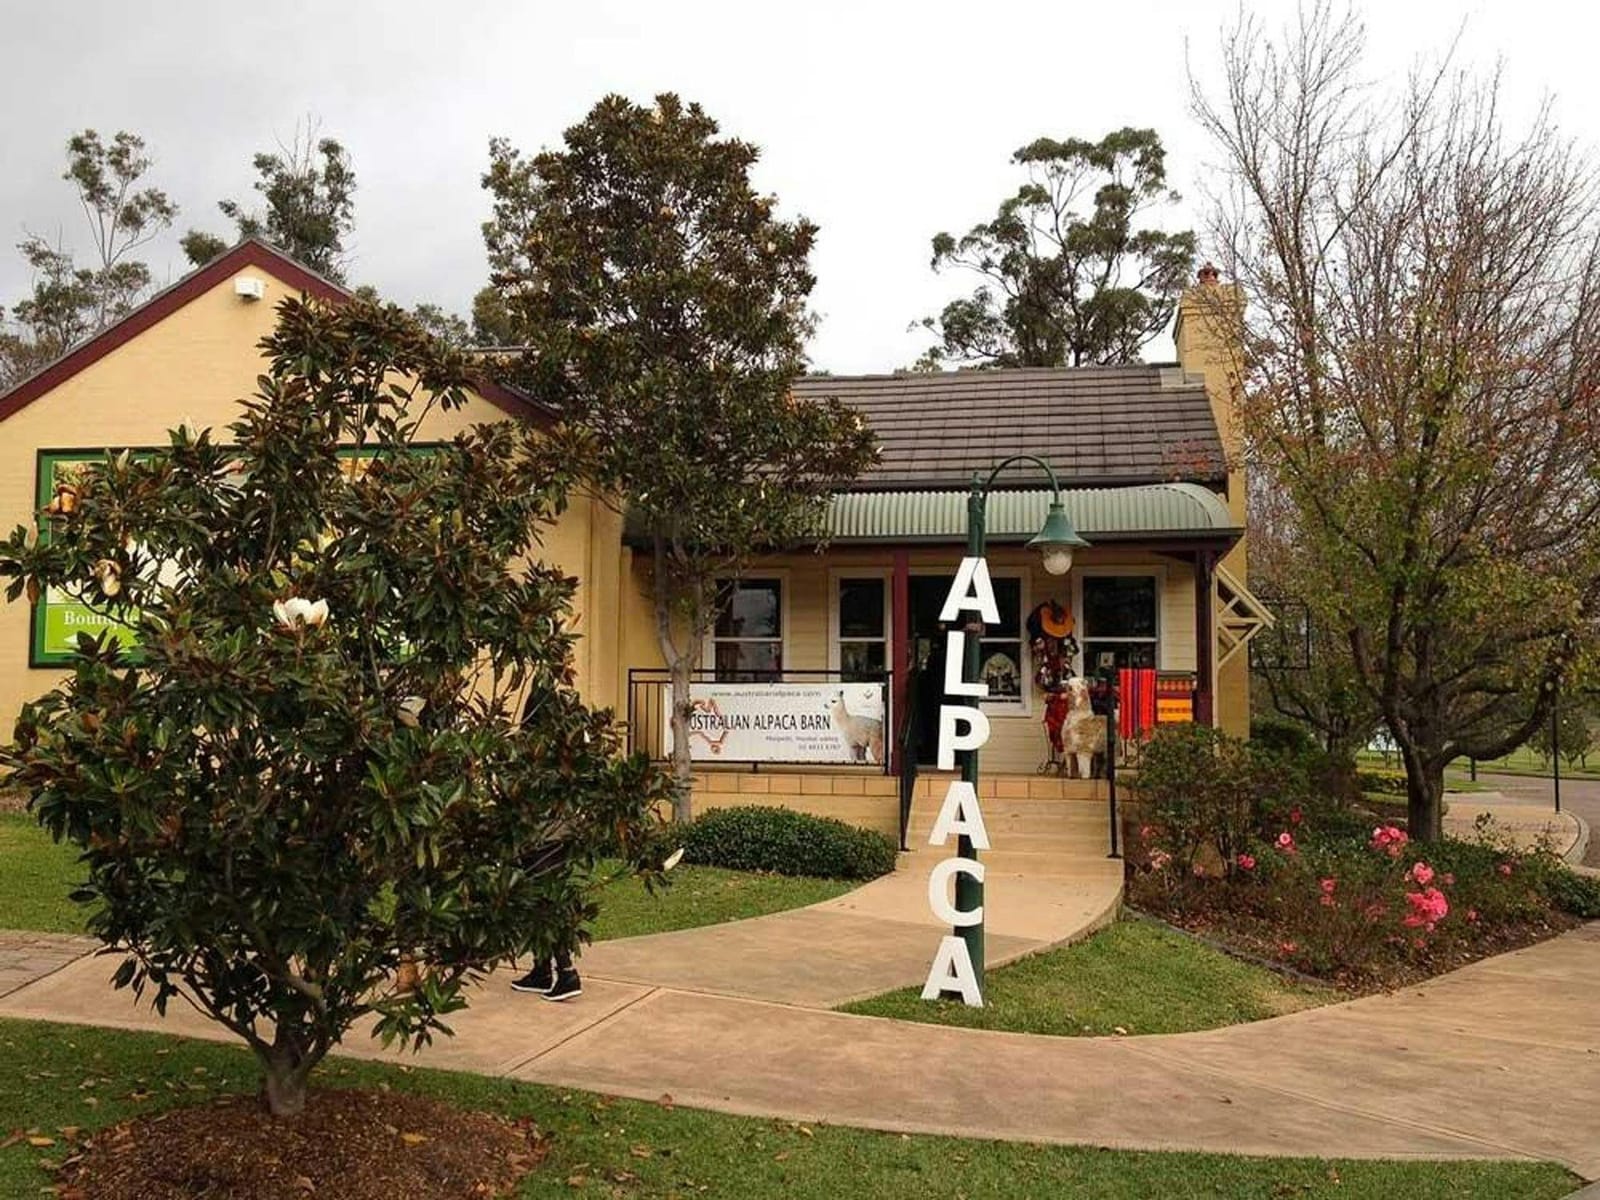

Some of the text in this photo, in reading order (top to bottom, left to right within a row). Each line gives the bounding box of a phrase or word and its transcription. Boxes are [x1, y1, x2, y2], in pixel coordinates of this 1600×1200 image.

[690, 714, 831, 730] USTRALIAN ALPACA BARN
[920, 556, 1000, 1008] ALPACA
